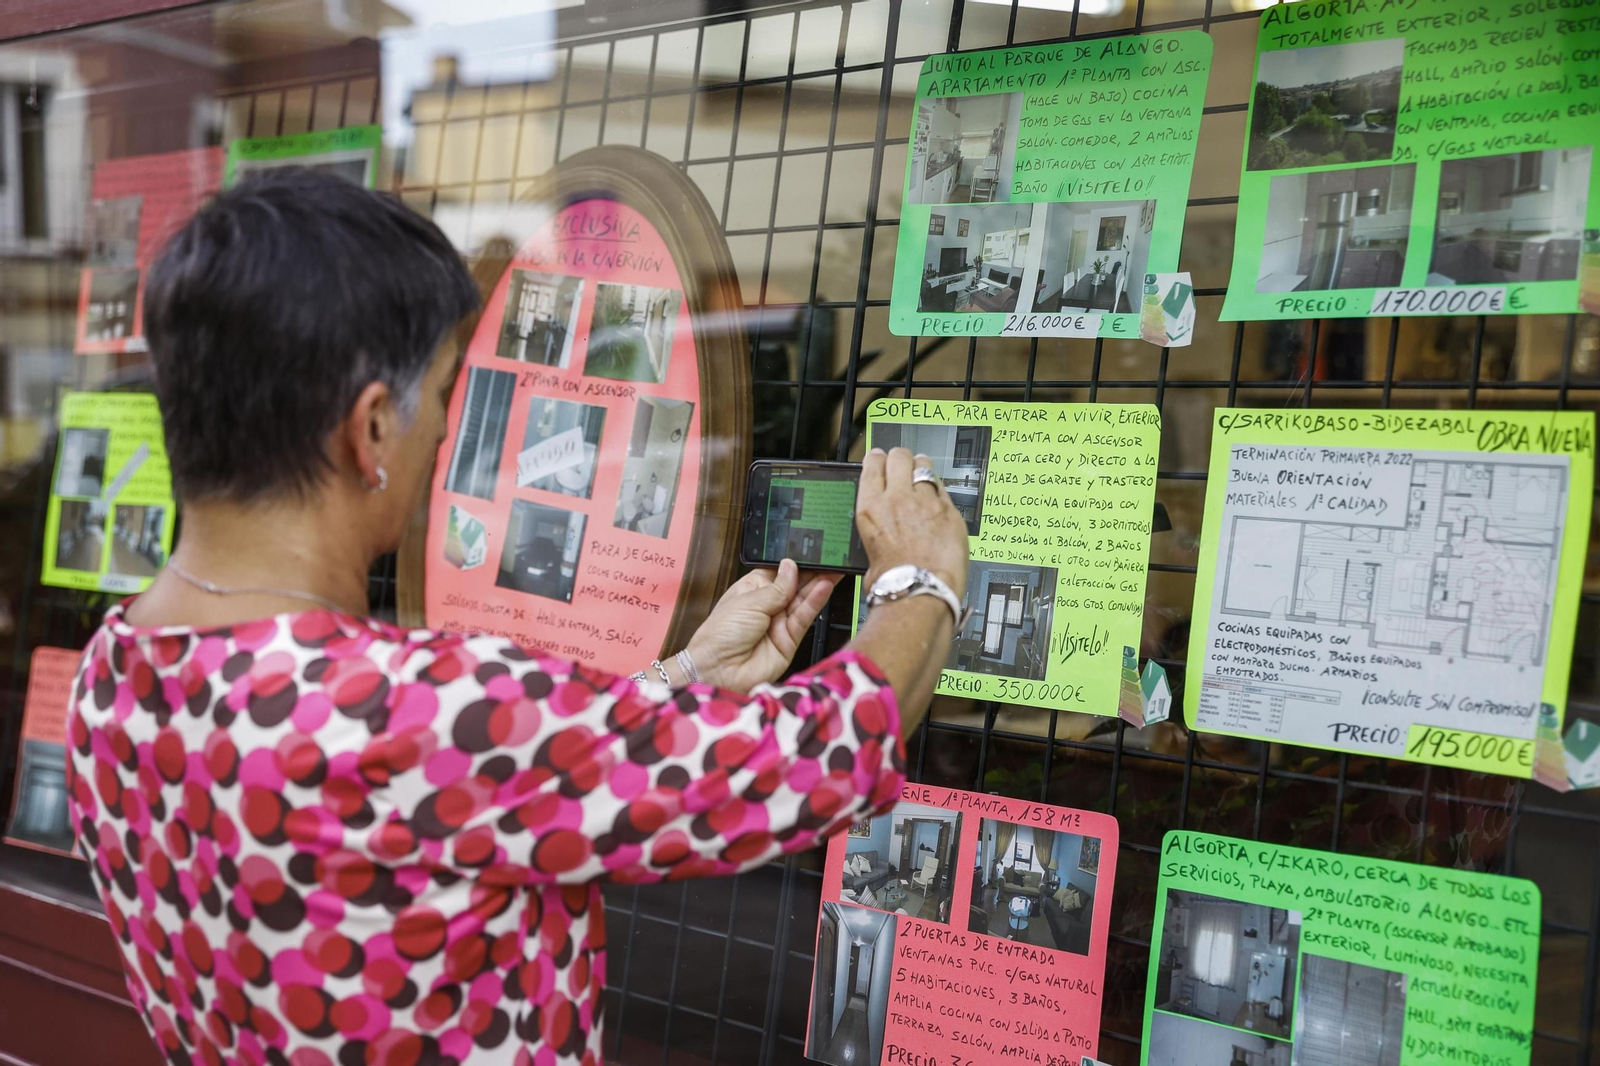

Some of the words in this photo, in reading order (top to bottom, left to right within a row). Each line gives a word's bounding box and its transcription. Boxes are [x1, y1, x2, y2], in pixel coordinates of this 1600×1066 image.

[1272, 21, 1384, 48] TOTALMENTE
[921, 57, 971, 76] JUNTO
[977, 55, 995, 71] AL
[1004, 49, 1063, 66] PARQUE
[1073, 47, 1091, 62] DE
[1100, 39, 1183, 60] ALANGO.
[1405, 38, 1477, 56] FACHADA
[927, 73, 1046, 96] APARTAMENTO
[1082, 68, 1130, 82] PLANTA
[1142, 62, 1167, 76] CON
[1173, 61, 1205, 74] ASC.
[1026, 95, 1058, 110] (HACE
[1067, 93, 1082, 104] UN
[1089, 88, 1127, 104] BAJO)
[1133, 85, 1188, 100] COCINA
[1020, 117, 1048, 127] TOMA
[1053, 116, 1067, 126] DE
[1072, 115, 1091, 125] GAS
[1099, 113, 1114, 123] EN
[1121, 110, 1132, 122] LA
[1139, 107, 1191, 120] VENTANA
[1502, 109, 1559, 123] COCINA
[1128, 131, 1140, 145] 2
[1146, 128, 1193, 143] AMPLIAS
[1016, 156, 1096, 172] HABITACIONES
[1104, 158, 1126, 170] CON
[1509, 287, 1528, 309] €
[1004, 315, 1085, 331] 216.000€
[584, 384, 635, 400] ASCENSOR
[870, 402, 950, 421] SOPELA,
[953, 404, 987, 420] PARA
[995, 409, 1047, 421] ENTRAR
[1057, 411, 1066, 422] A
[1074, 408, 1115, 428] VIVIR,
[1119, 409, 1161, 431] EXTERIOR
[1009, 431, 1050, 442] PLANTA
[1058, 433, 1078, 444] CON
[1082, 434, 1142, 447] ASCENSOR
[1477, 421, 1529, 452] OBRA
[991, 452, 998, 462] A
[1004, 453, 1030, 463] COTA
[1035, 454, 1061, 464] CERO
[1078, 454, 1126, 467] DIRECTO
[1145, 454, 1155, 465] LA
[1231, 447, 1315, 461] TERMINACIÓN
[1320, 450, 1379, 464] PRIMAVERA
[1384, 452, 1413, 465] 2022
[989, 471, 1018, 484] PLAZA
[1022, 474, 1035, 485] DE
[1039, 474, 1081, 485] GARAJE
[1099, 476, 1153, 486] TRASTERO
[1230, 469, 1268, 484] BUENA
[1277, 470, 1372, 489] ORIENTACIÓN
[985, 494, 1016, 507] HALL,
[1020, 496, 1058, 508] COCINA
[1065, 498, 1113, 510] EQUIPADA
[1120, 501, 1138, 509] CON
[1226, 491, 1296, 508] MATERIALES
[1327, 497, 1387, 516] CALIDAD
[982, 514, 1040, 529] TENDEDERO,
[1047, 516, 1081, 531] SALÓN,
[1090, 519, 1096, 529] 3
[1100, 519, 1150, 535] DORMITORIOS
[1011, 533, 1038, 545] SALIDA
[1057, 534, 1090, 551] BALCÓN,
[1095, 540, 1102, 550] 2
[1107, 540, 1141, 552] BAÑOS
[979, 547, 1004, 558] PLATO
[1008, 550, 1034, 561] DUCHA
[1051, 554, 1061, 563] EL
[1068, 556, 1089, 567] OTRO
[1114, 557, 1144, 574] BAÑERA
[1061, 573, 1116, 589] CALEFACCIÓN
[1120, 581, 1138, 592] GAS
[1057, 596, 1079, 608] POCOS
[1218, 622, 1260, 637] COCINAS
[1266, 627, 1322, 648] EQUIPADAS
[1330, 636, 1350, 644] CON
[1211, 654, 1231, 664] CON
[1233, 655, 1274, 670] MAMPARA
[1320, 666, 1377, 682] ARMARIOS
[1329, 648, 1365, 664] BAÑOS
[1370, 655, 1422, 669] EQUIPADOS
[1213, 666, 1283, 685] EMPOTRADOS.
[937, 674, 988, 692] PRECIO:
[993, 679, 1085, 702] 350.000€
[1426, 693, 1451, 714] SIN
[1409, 725, 1531, 766] 195.000€
[960, 793, 1013, 820] PLANTA,
[1018, 805, 1055, 825] 158
[1166, 835, 1252, 869] ALGORTA,
[1258, 850, 1348, 880] C/IKARO,
[1355, 866, 1410, 886] CERCA
[1418, 873, 1438, 890] DE
[1445, 880, 1494, 900] TODOS
[1501, 885, 1531, 905] LOS
[1162, 863, 1244, 890] SERVICIOS,
[1250, 877, 1299, 900] PLAYA,
[1304, 886, 1410, 913] AMBULATORIO
[1326, 911, 1380, 933] PLANTA
[901, 921, 912, 936] 2
[915, 924, 966, 947] PUERTAS
[974, 936, 988, 951] DE
[997, 942, 1054, 965] ENTRADA
[900, 945, 962, 968] VENTANAS
[969, 958, 996, 975] P.V.C.
[1005, 967, 1040, 984] C/GAS
[1045, 974, 1097, 995] NATURAL
[896, 968, 906, 981] 5
[910, 972, 1001, 1007] HABITACIONES,
[1009, 992, 1017, 1004] 3
[1022, 993, 1066, 1015] BAÑOS,
[894, 992, 932, 1013] AMPLIA
[940, 1006, 982, 1025] COCINA
[990, 1019, 1010, 1031] CON
[1015, 1021, 1049, 1040] SALIDA
[1062, 1028, 1091, 1050] PATIO
[891, 1013, 944, 1038] TERRAZA,
[951, 1031, 994, 1054] SALÓN,
[1000, 1045, 1041, 1064] AMPLIA
